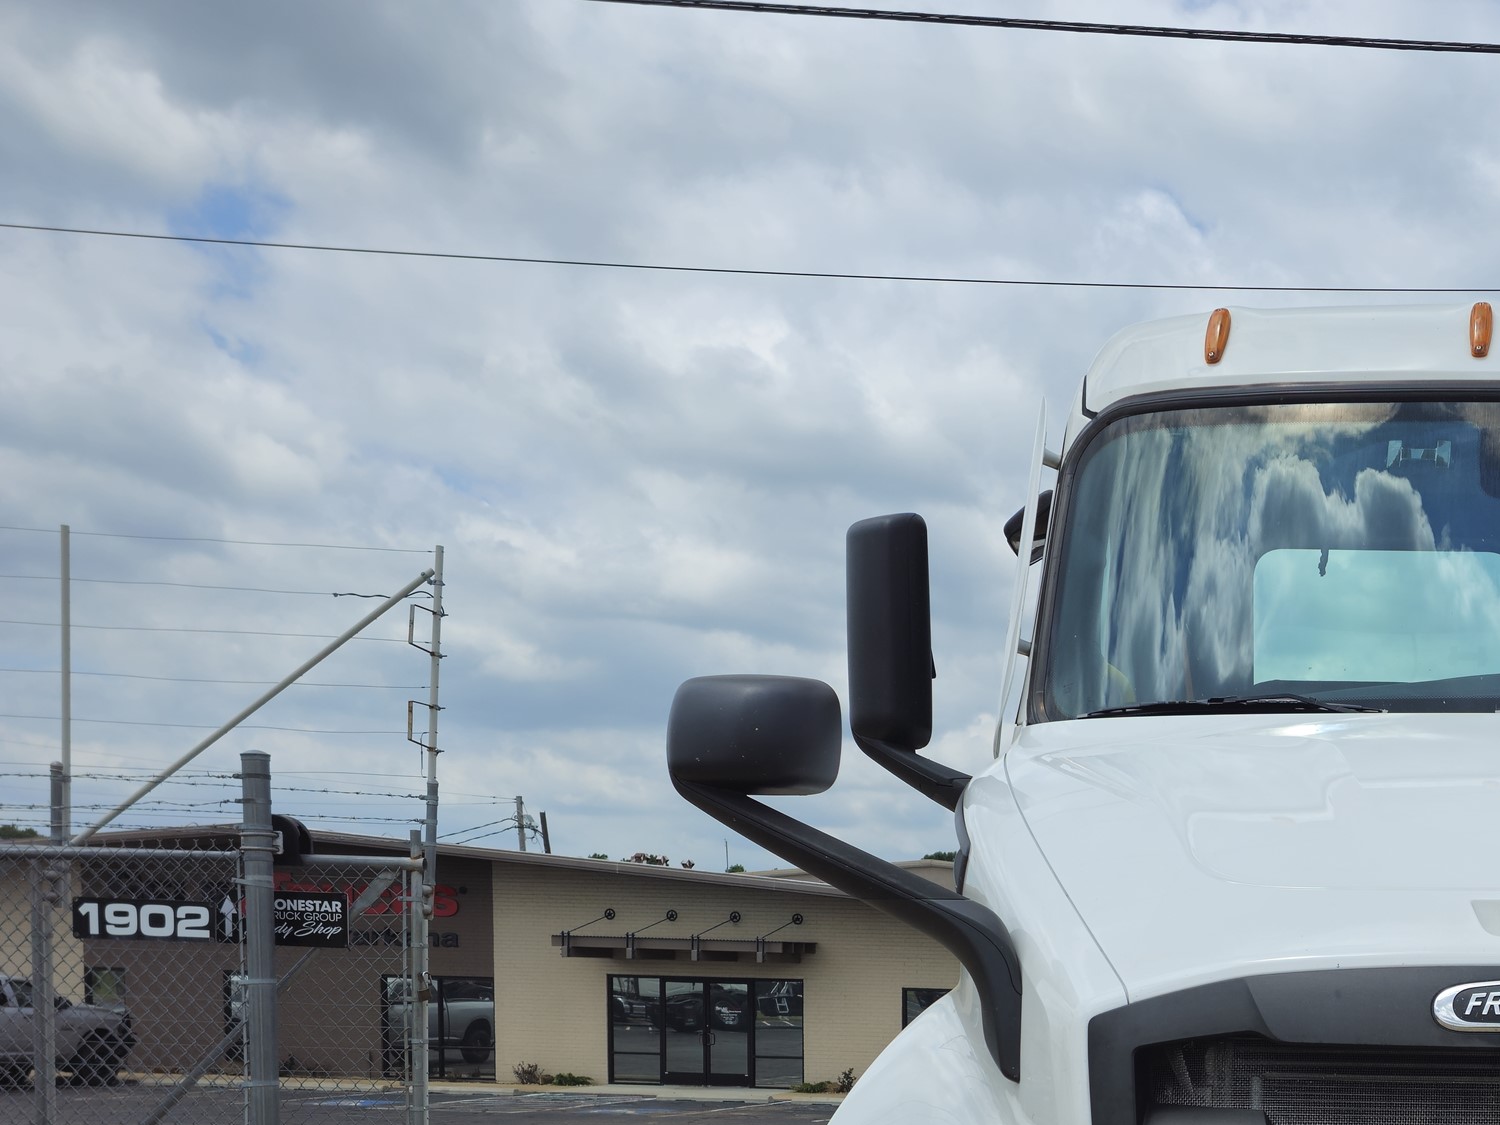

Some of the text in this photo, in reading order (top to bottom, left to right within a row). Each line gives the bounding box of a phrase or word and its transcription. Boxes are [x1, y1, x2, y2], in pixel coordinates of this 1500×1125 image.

[273, 898, 343, 913] ONESTAR
[78, 902, 211, 938] 1902
[273, 911, 343, 922] RUCK GROUP
[273, 920, 343, 940] dy Shop
